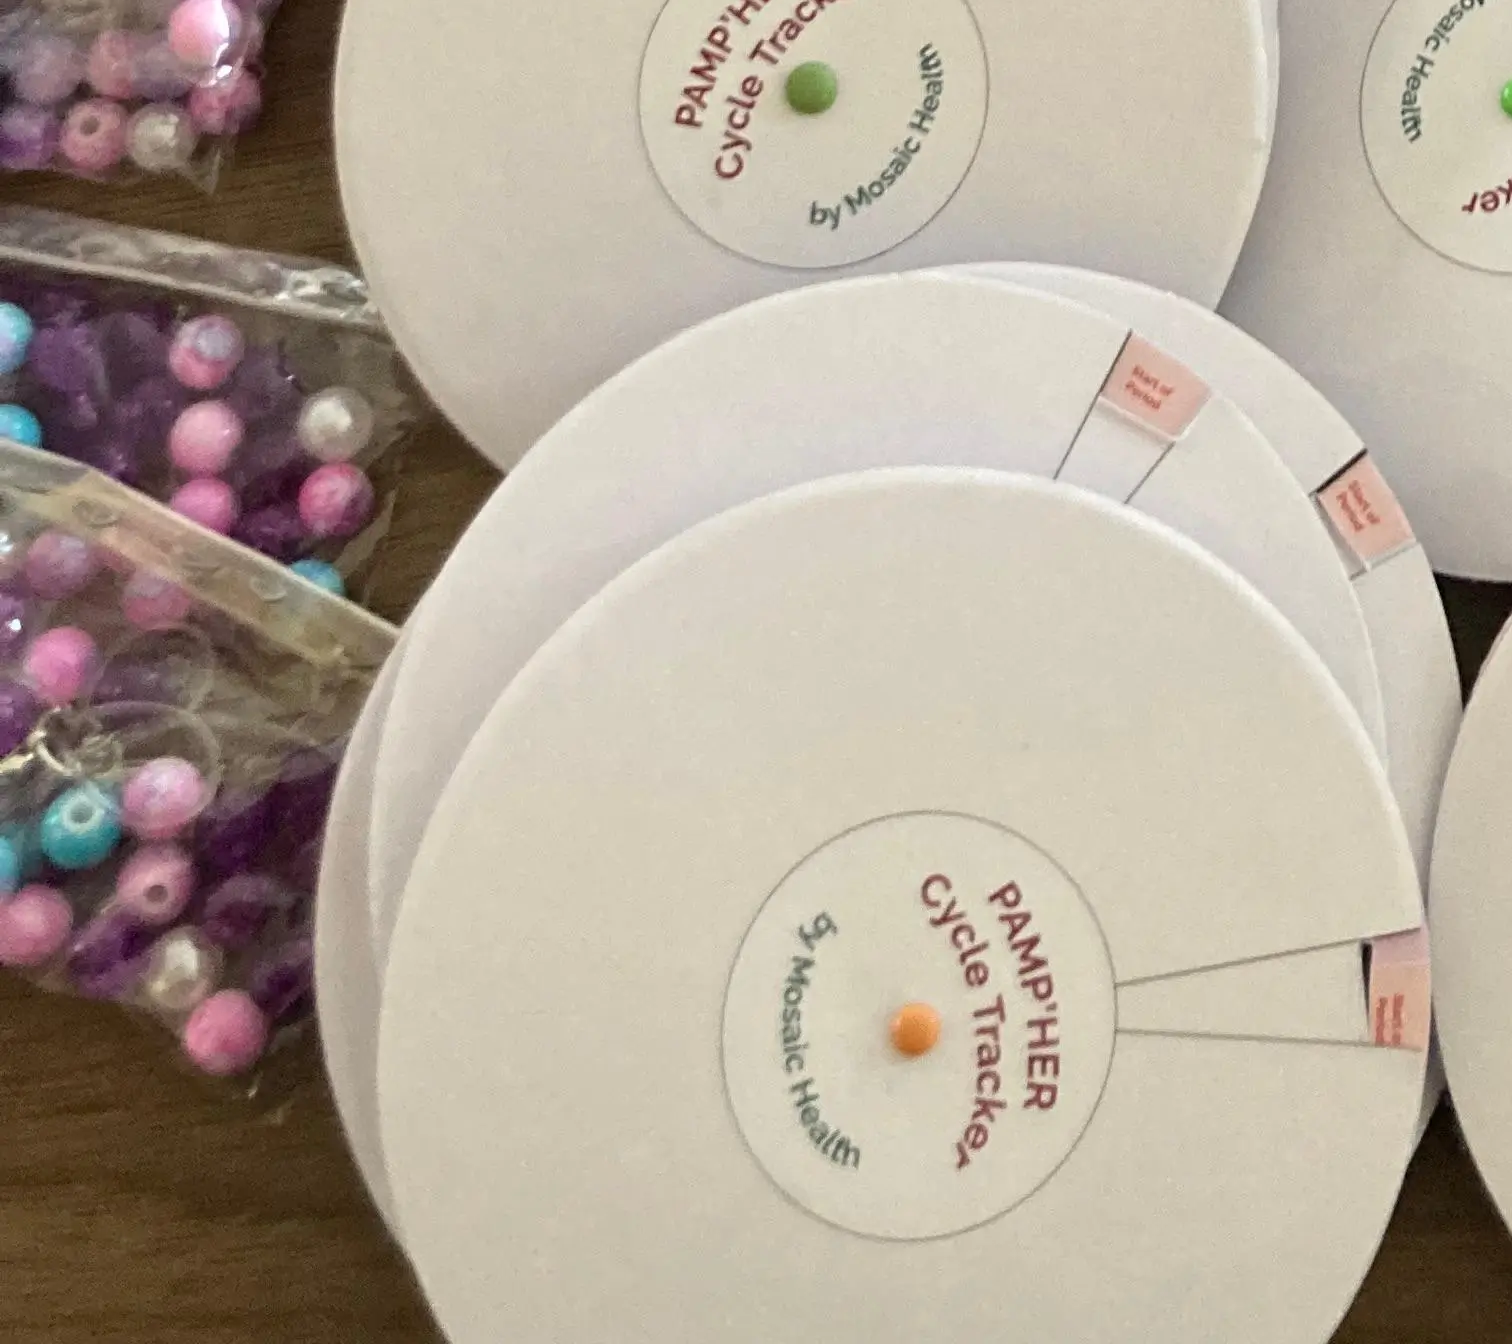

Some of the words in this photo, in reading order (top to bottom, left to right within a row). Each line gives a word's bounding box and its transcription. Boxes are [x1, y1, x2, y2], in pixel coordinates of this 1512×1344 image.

[714, 74, 763, 180] Cycle
[808, 200, 842, 230] by
[843, 135, 921, 216] Mosaic
[909, 42, 944, 135] Health
[1401, 54, 1434, 143] Health
[798, 911, 838, 951] by
[782, 955, 816, 1075] Mosaic
[921, 873, 989, 988] Cycle
[955, 994, 1007, 1170] Tracker
[989, 881, 1060, 1111] PAMP'HER
